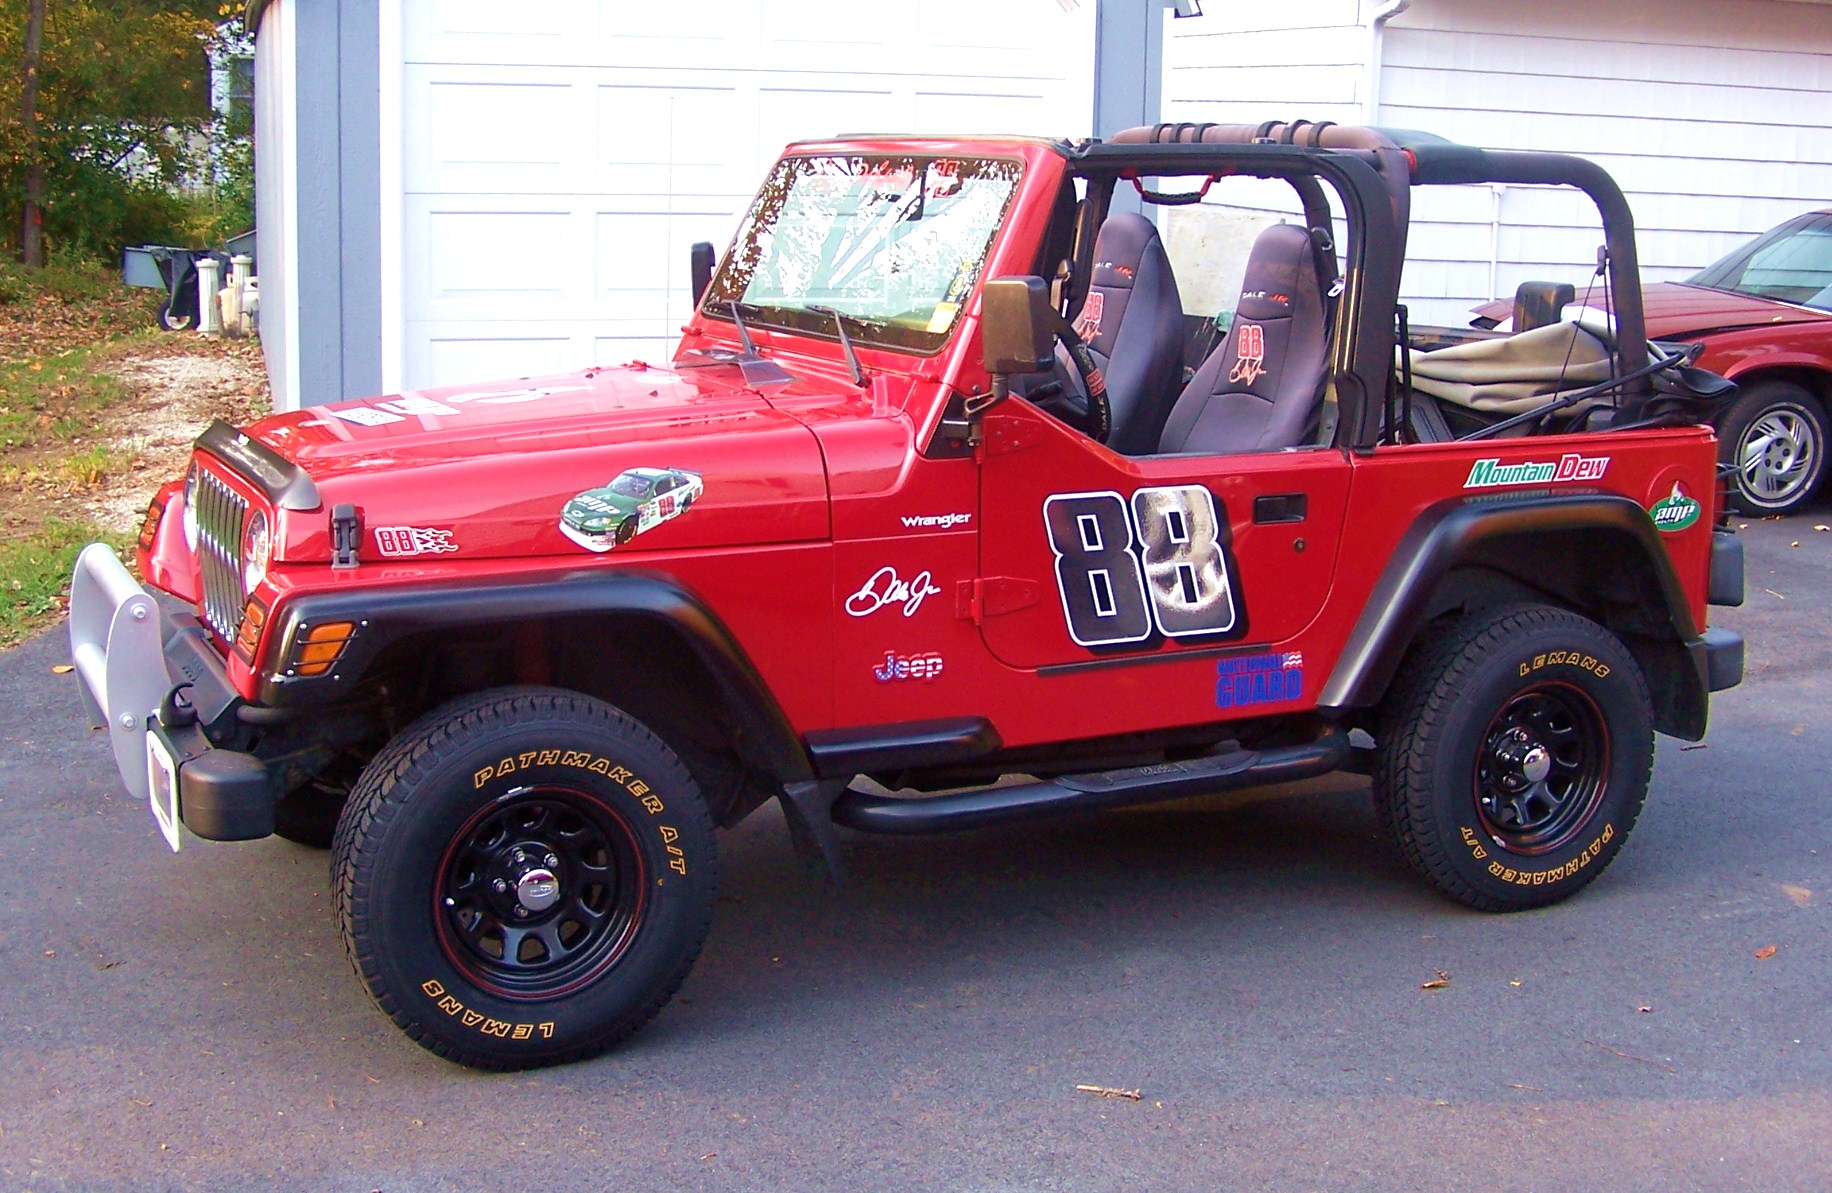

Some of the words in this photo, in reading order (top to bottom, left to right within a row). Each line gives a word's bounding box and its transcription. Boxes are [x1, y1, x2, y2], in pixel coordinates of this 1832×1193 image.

[1238, 324, 1264, 361] 88
[1464, 459, 1556, 488] Mountain
[1554, 454, 1610, 481] Dew
[658, 495, 676, 519] 88
[901, 513, 972, 528] Wrangler
[375, 526, 420, 557] 88
[1043, 484, 1235, 647] 88
[873, 653, 943, 682] Jeep
[1519, 652, 1610, 678] LEMANS
[1216, 669, 1303, 709] GUARD
[475, 750, 664, 815] PATHMAKER
[660, 825, 686, 875] A/T
[1488, 823, 1614, 886] PATHMAKER
[422, 979, 554, 1040] LEMANS
